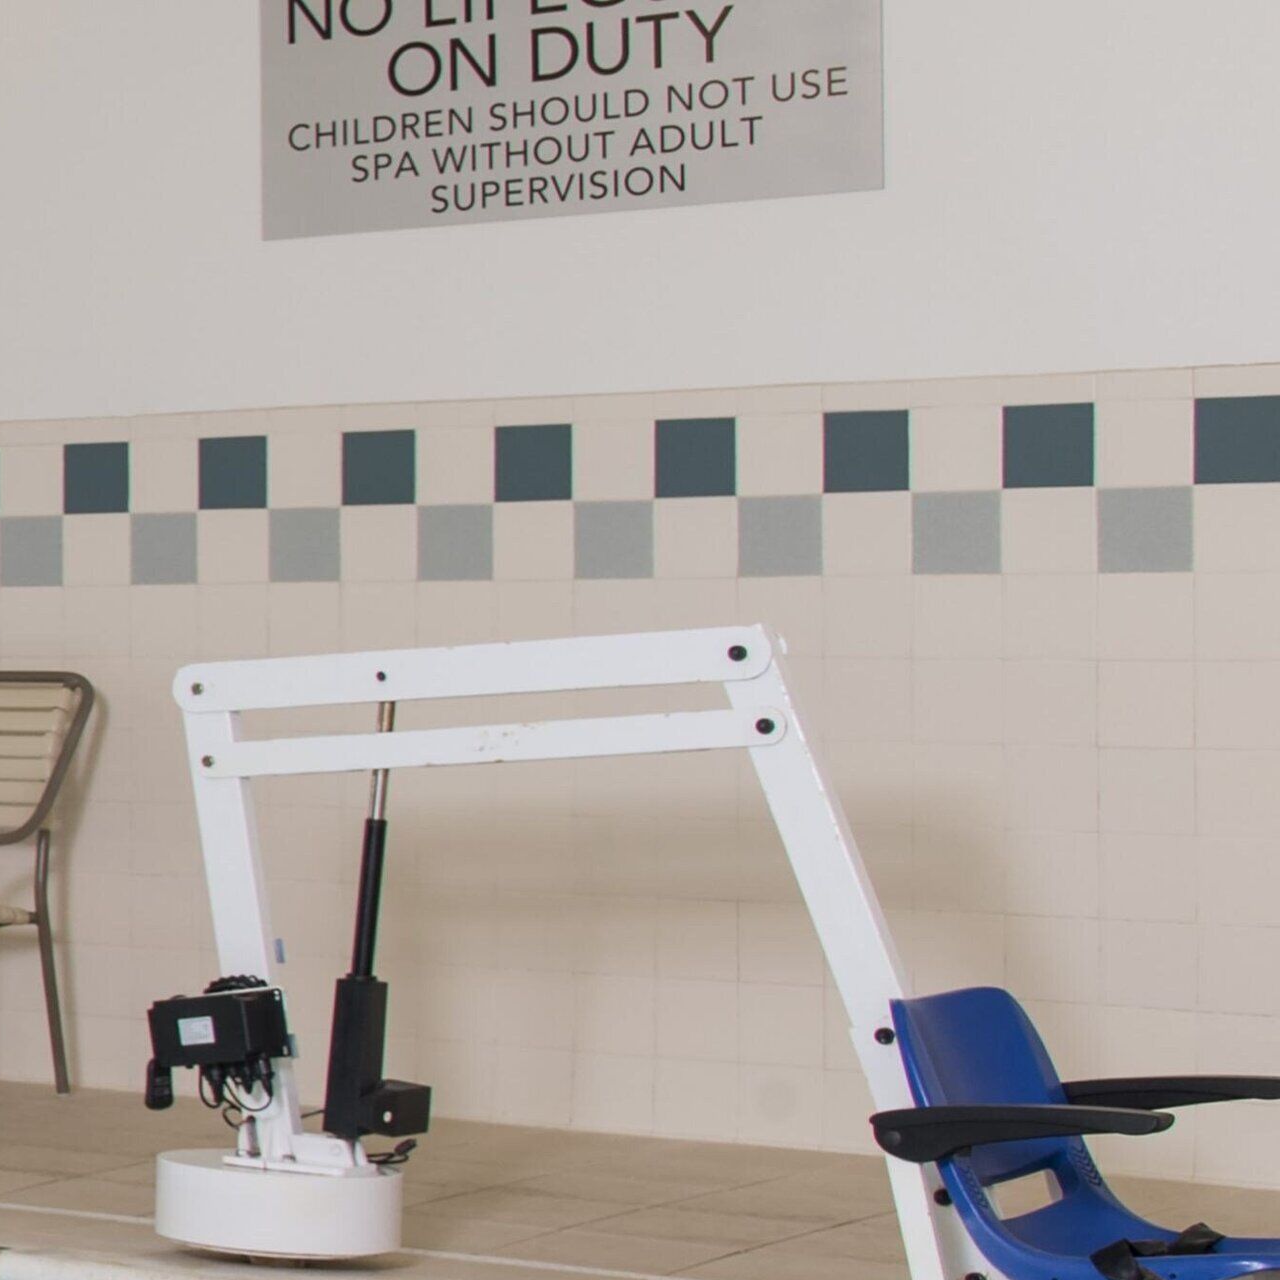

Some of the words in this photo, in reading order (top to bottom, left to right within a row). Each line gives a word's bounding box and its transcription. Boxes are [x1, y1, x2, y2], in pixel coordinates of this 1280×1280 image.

[288, 0, 392, 44] NO
[388, 33, 497, 97] ON
[530, 5, 734, 83] DUTY
[288, 106, 473, 152] CHILDREN
[489, 89, 650, 132] SHOULD
[666, 76, 756, 114] NOT
[771, 66, 849, 103] USE
[350, 150, 420, 183] SPA
[432, 131, 616, 175] WITHOUT
[630, 116, 764, 156] ADULT
[430, 164, 687, 213] SUPERVISION
